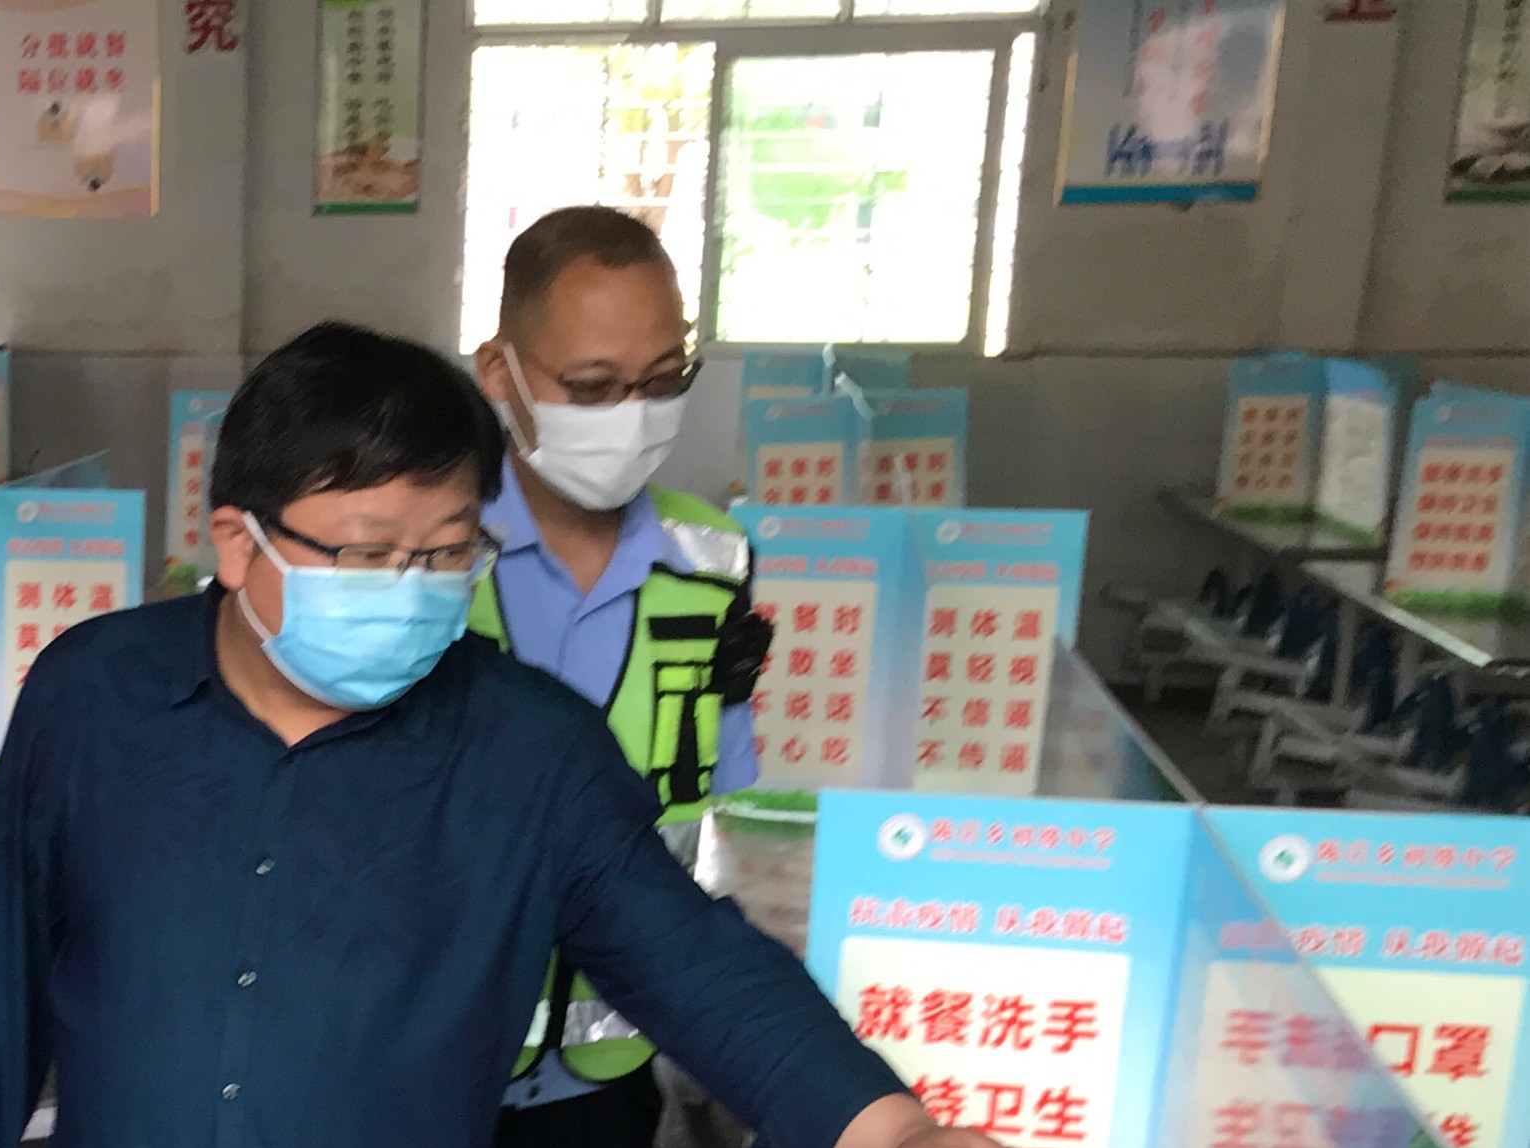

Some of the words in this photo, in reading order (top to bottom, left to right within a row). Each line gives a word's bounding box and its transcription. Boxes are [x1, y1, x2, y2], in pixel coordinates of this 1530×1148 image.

[184, 0, 238, 53] 究
[17, 581, 115, 611] 测体温
[929, 606, 1042, 640] 测体温
[758, 646, 856, 679] 散坐
[853, 983, 1099, 1054] 就餐洗手
[1368, 1023, 1492, 1081] 口罩
[911, 1076, 1089, 1142] 持卫生
